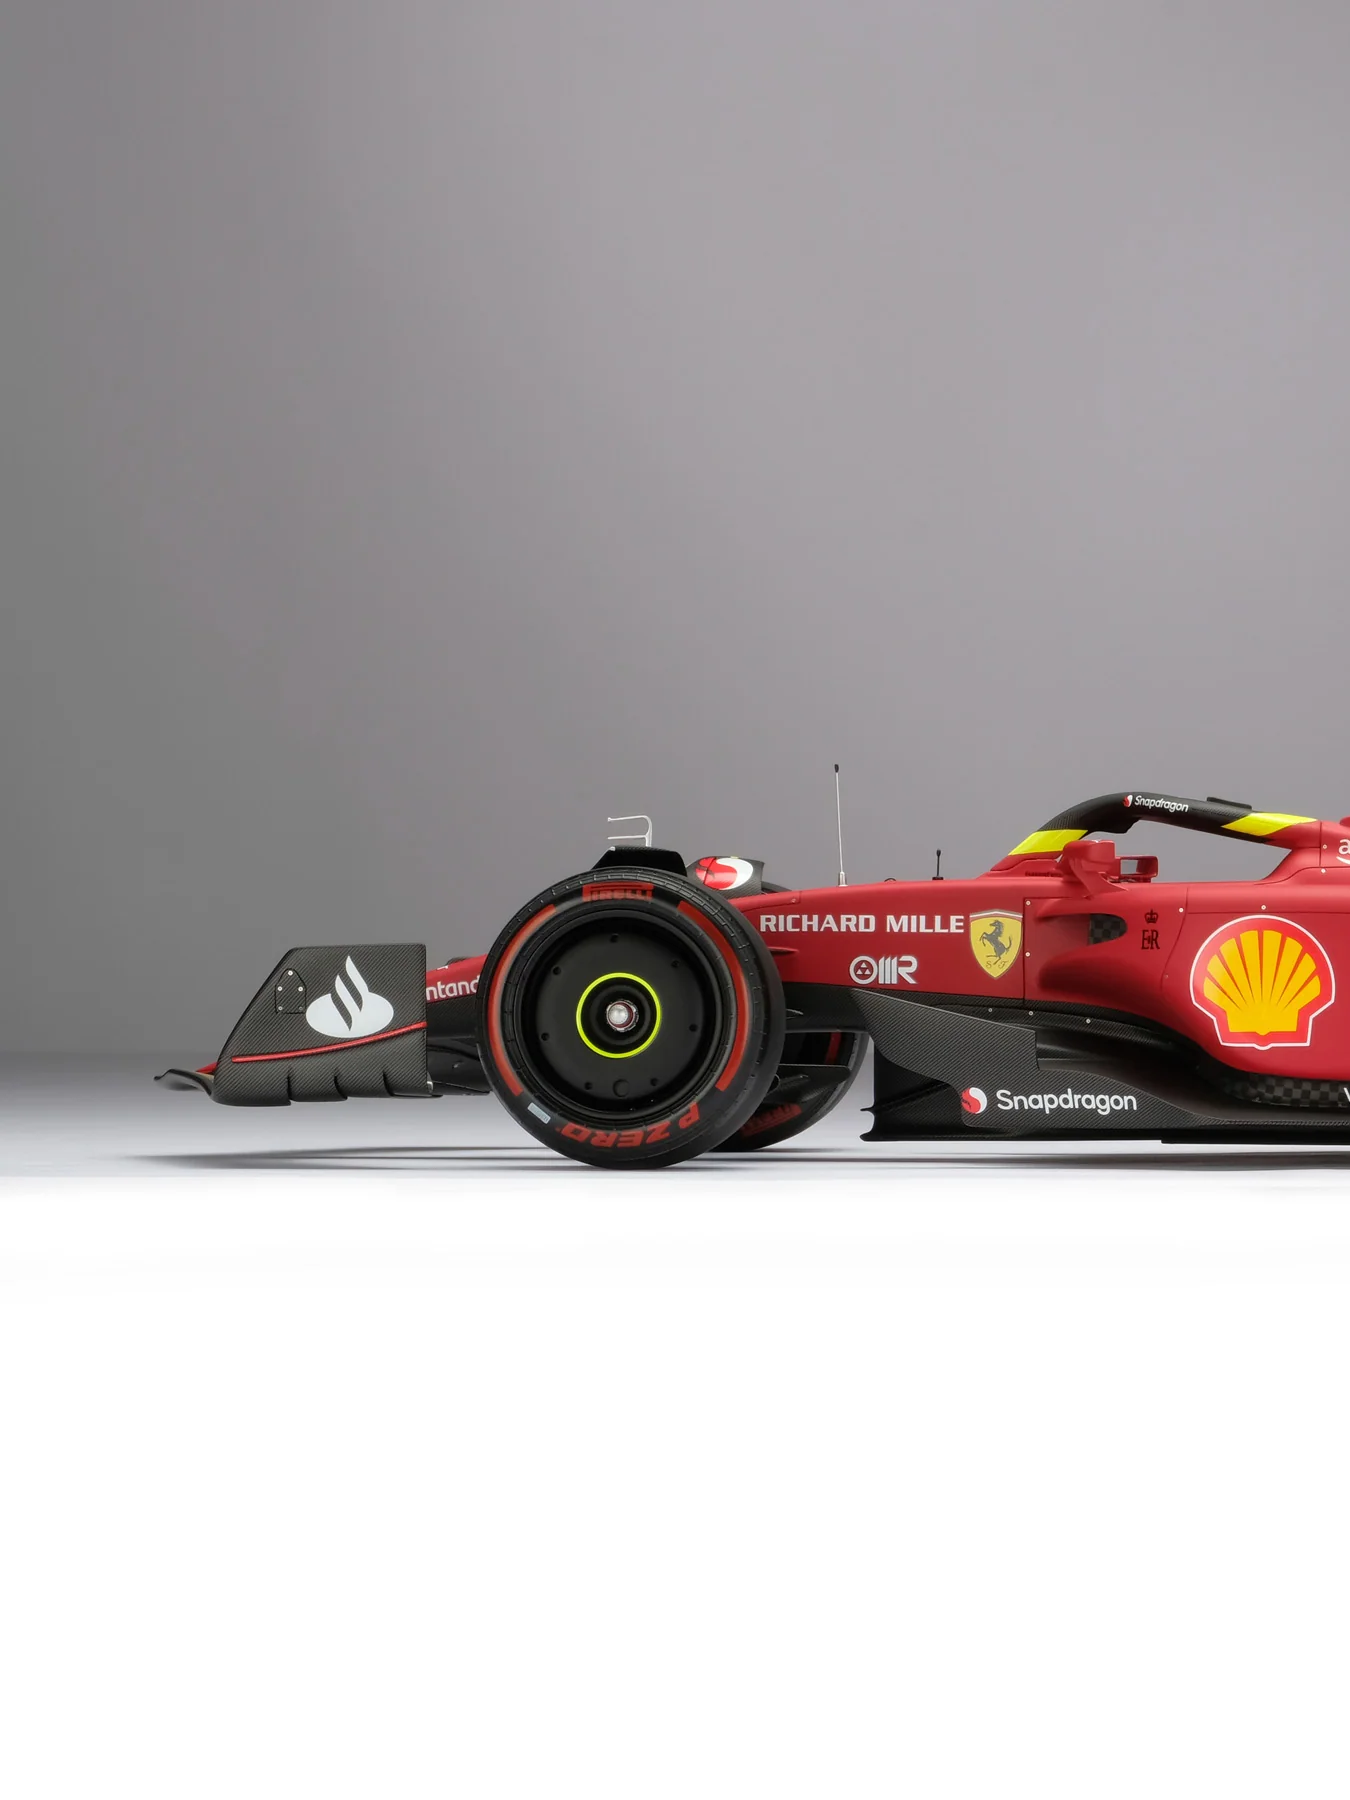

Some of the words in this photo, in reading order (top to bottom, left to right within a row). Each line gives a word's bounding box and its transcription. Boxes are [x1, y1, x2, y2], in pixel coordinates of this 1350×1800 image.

[1134, 795, 1189, 813] Snapdragon
[582, 881, 654, 902] PIRELLI
[759, 914, 875, 933] RICHARD
[885, 914, 965, 933] MILLE
[425, 974, 480, 1001] ntand
[678, 1101, 700, 1128] P
[996, 1089, 1138, 1115] Snapdragon
[561, 1122, 671, 1148] ZERO
